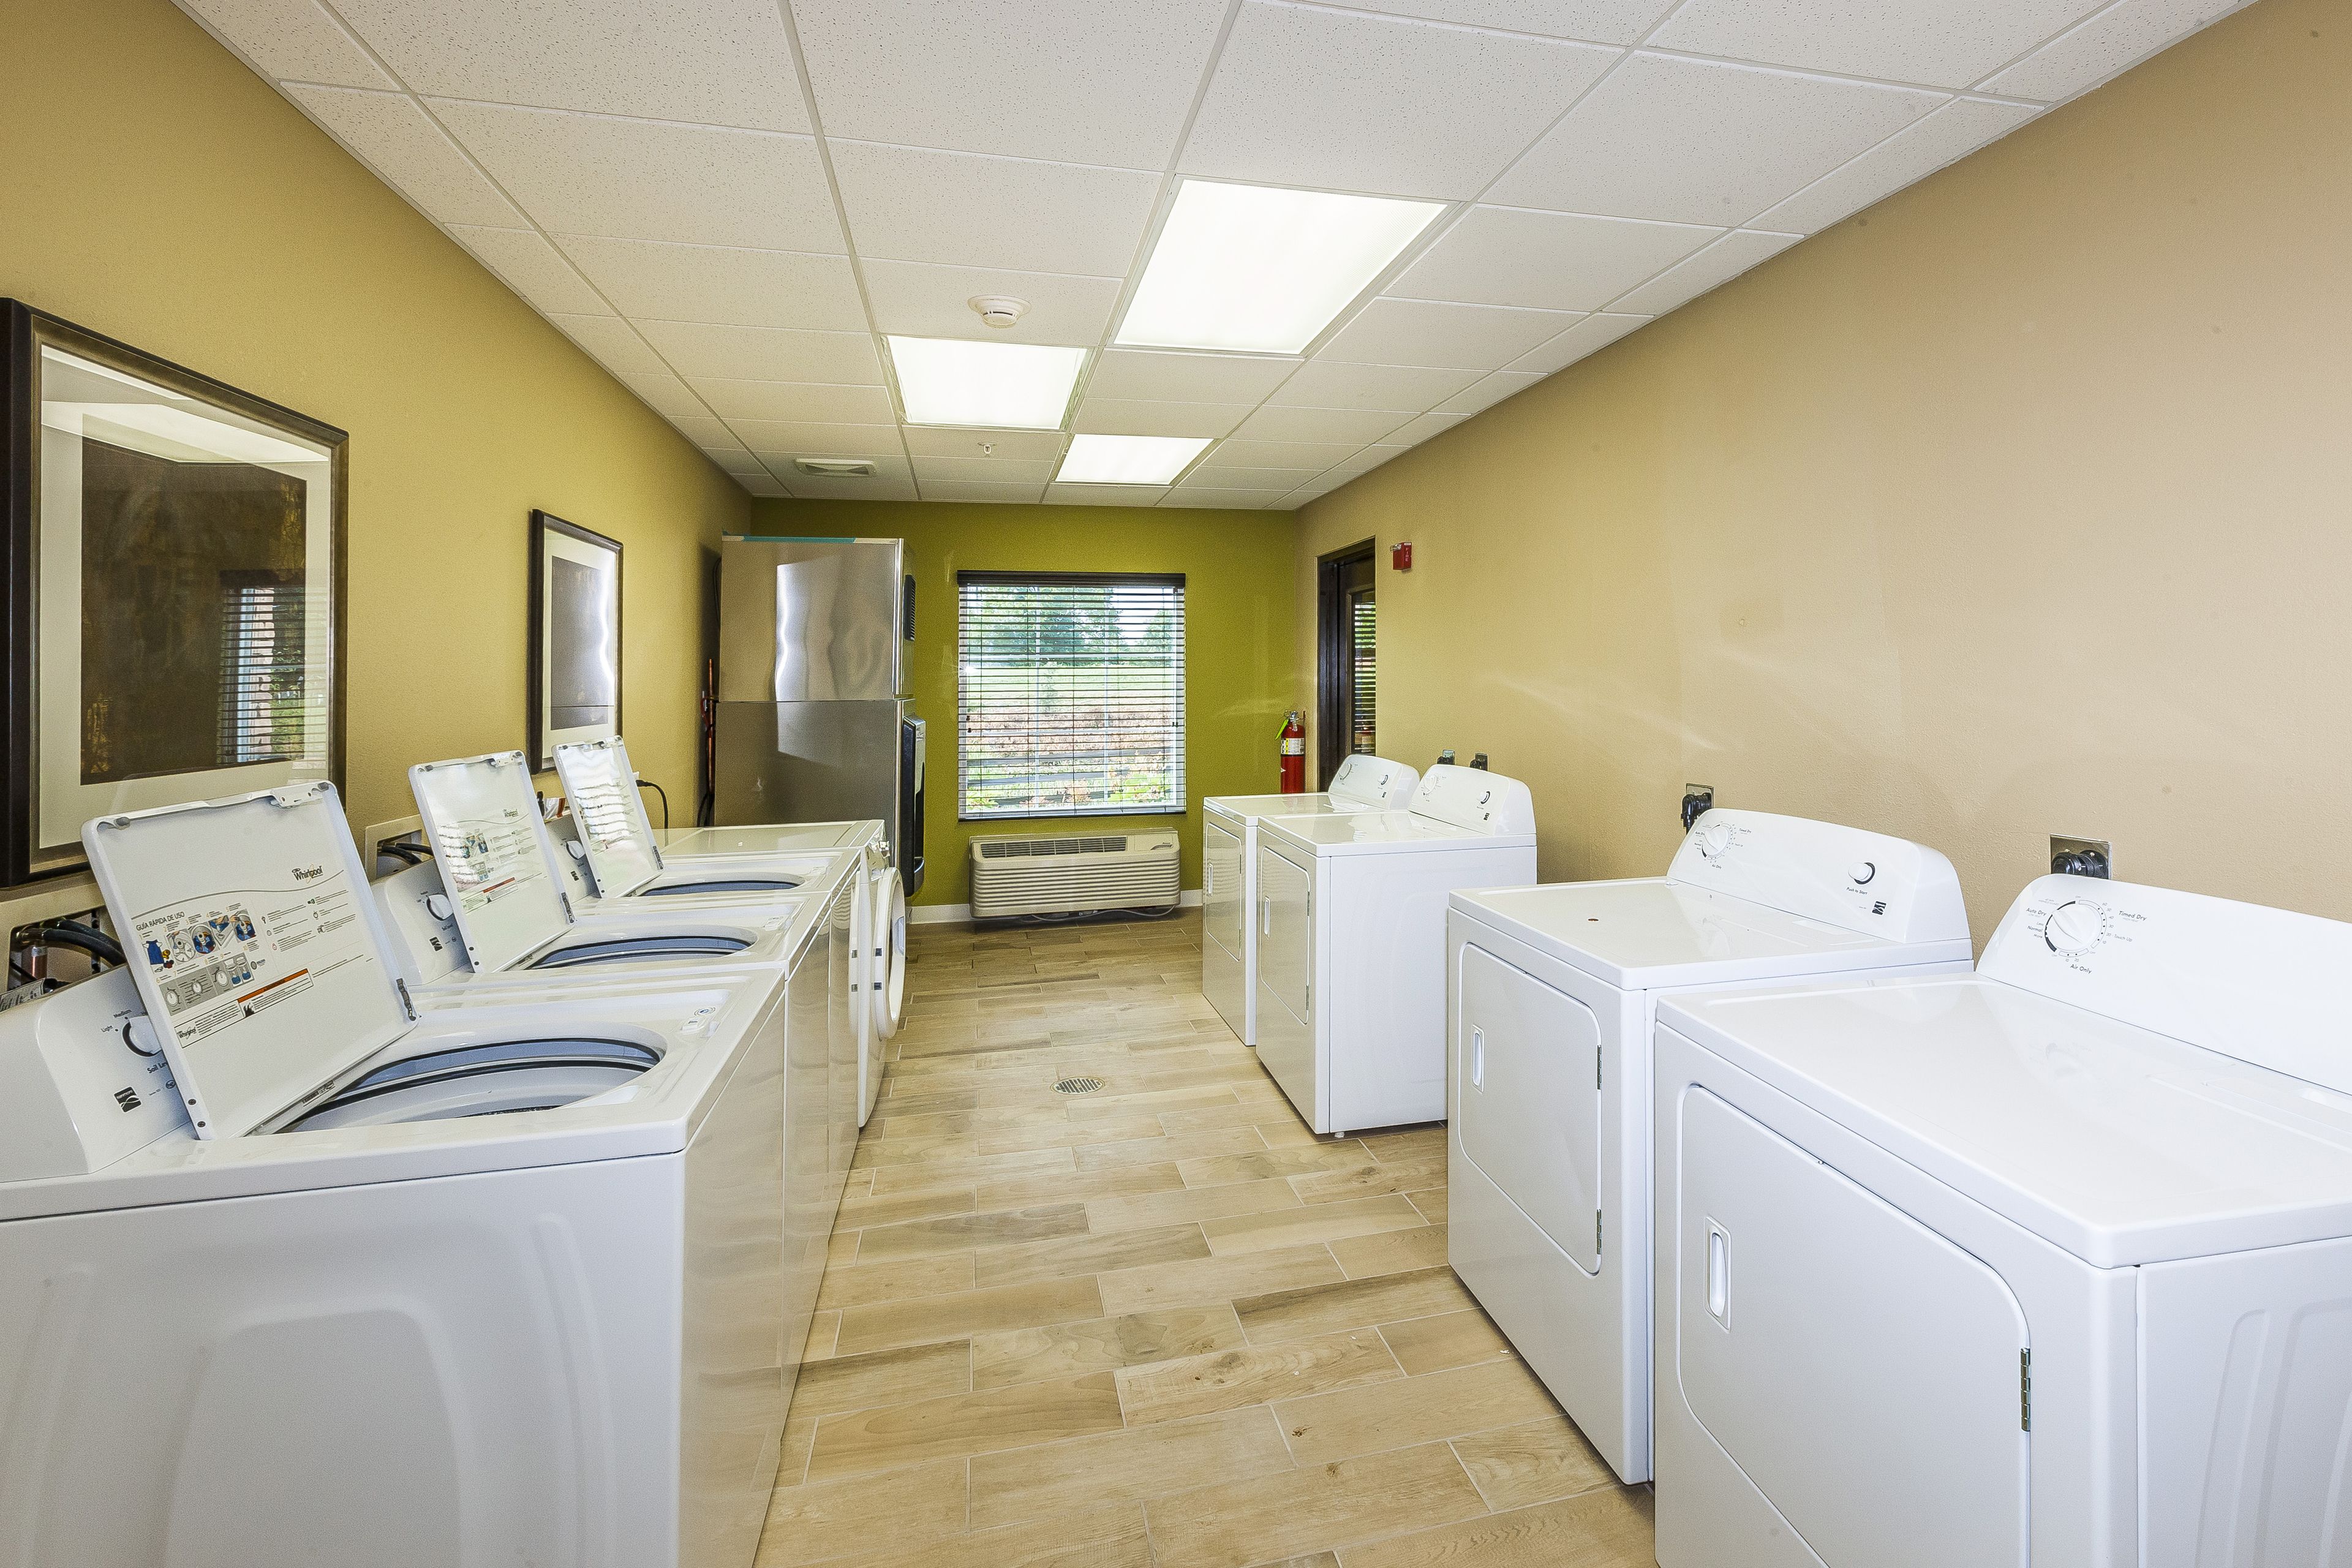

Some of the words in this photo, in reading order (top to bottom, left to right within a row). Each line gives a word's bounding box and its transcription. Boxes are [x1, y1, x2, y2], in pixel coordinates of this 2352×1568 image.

[294, 865, 323, 881] Whirlpool
[136, 922, 149, 931] GUÍA
[147, 1065, 159, 1074] Soil
